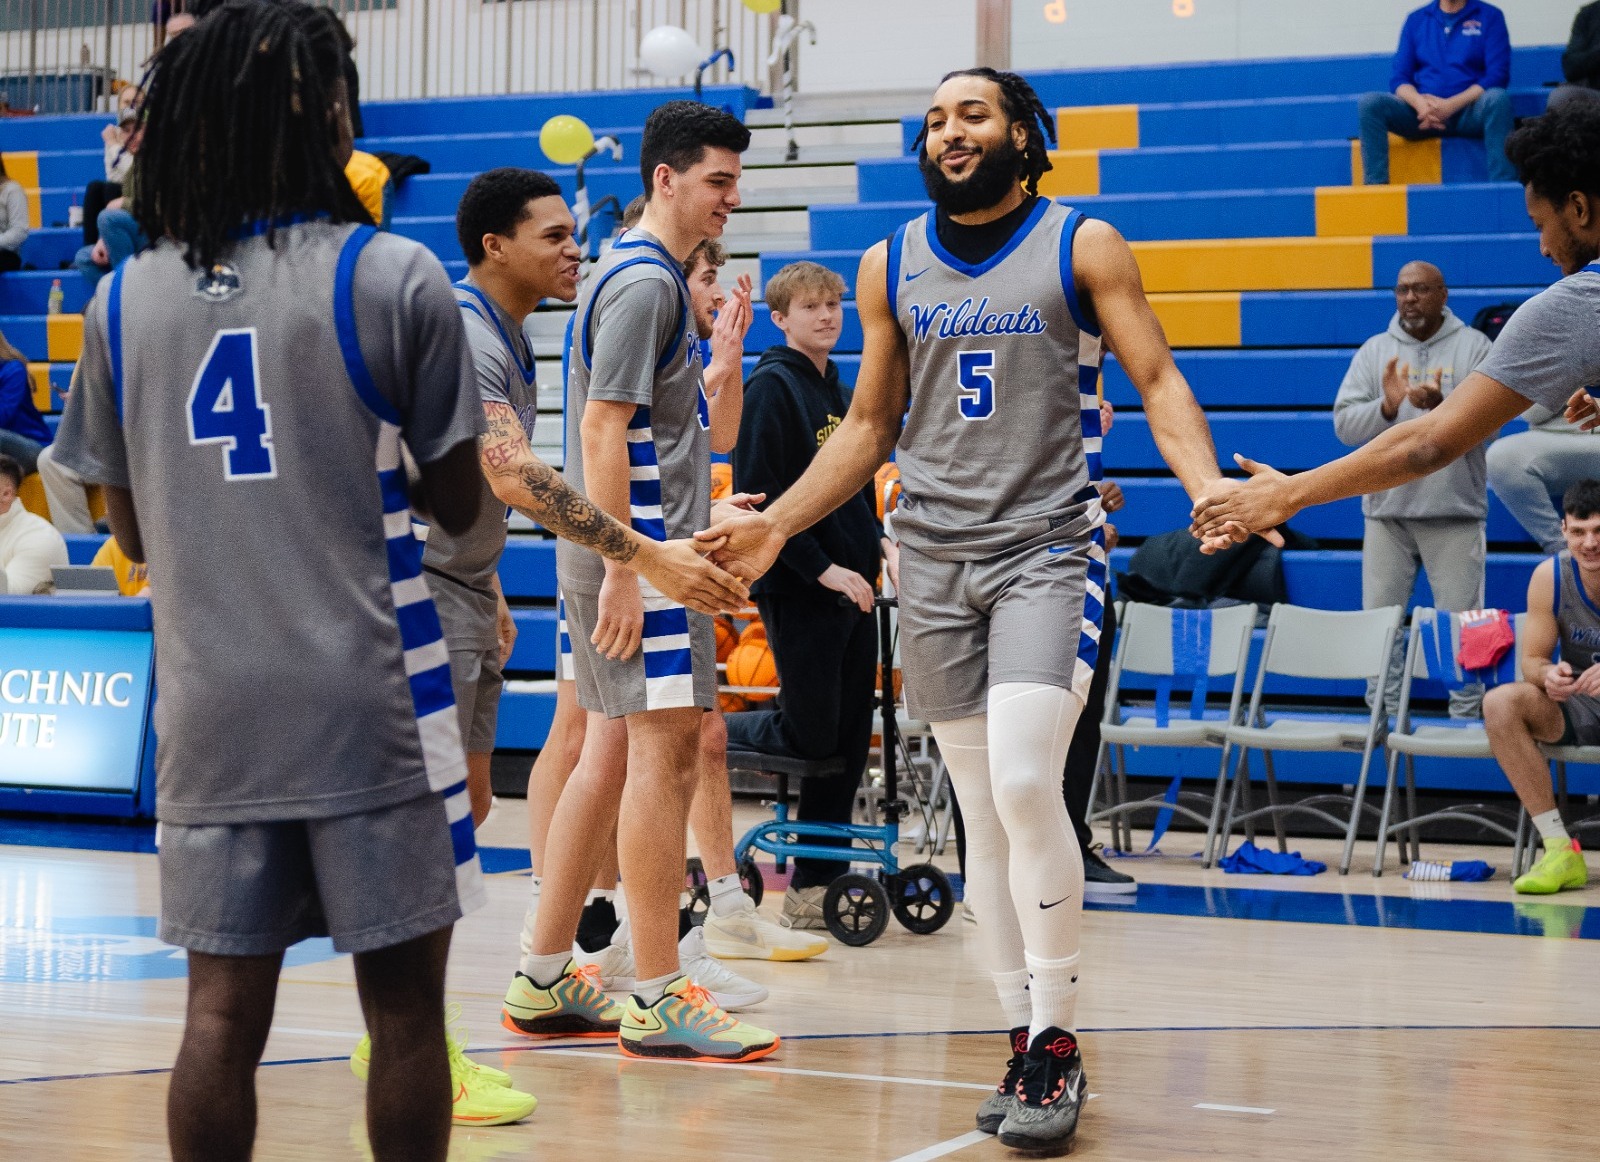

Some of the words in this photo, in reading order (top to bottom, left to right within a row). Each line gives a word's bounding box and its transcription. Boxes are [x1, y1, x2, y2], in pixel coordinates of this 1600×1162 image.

[909, 296, 1048, 345] Wildcats
[185, 326, 278, 482] 4
[957, 350, 996, 421] 5
[0, 669, 133, 708] CHNIC
